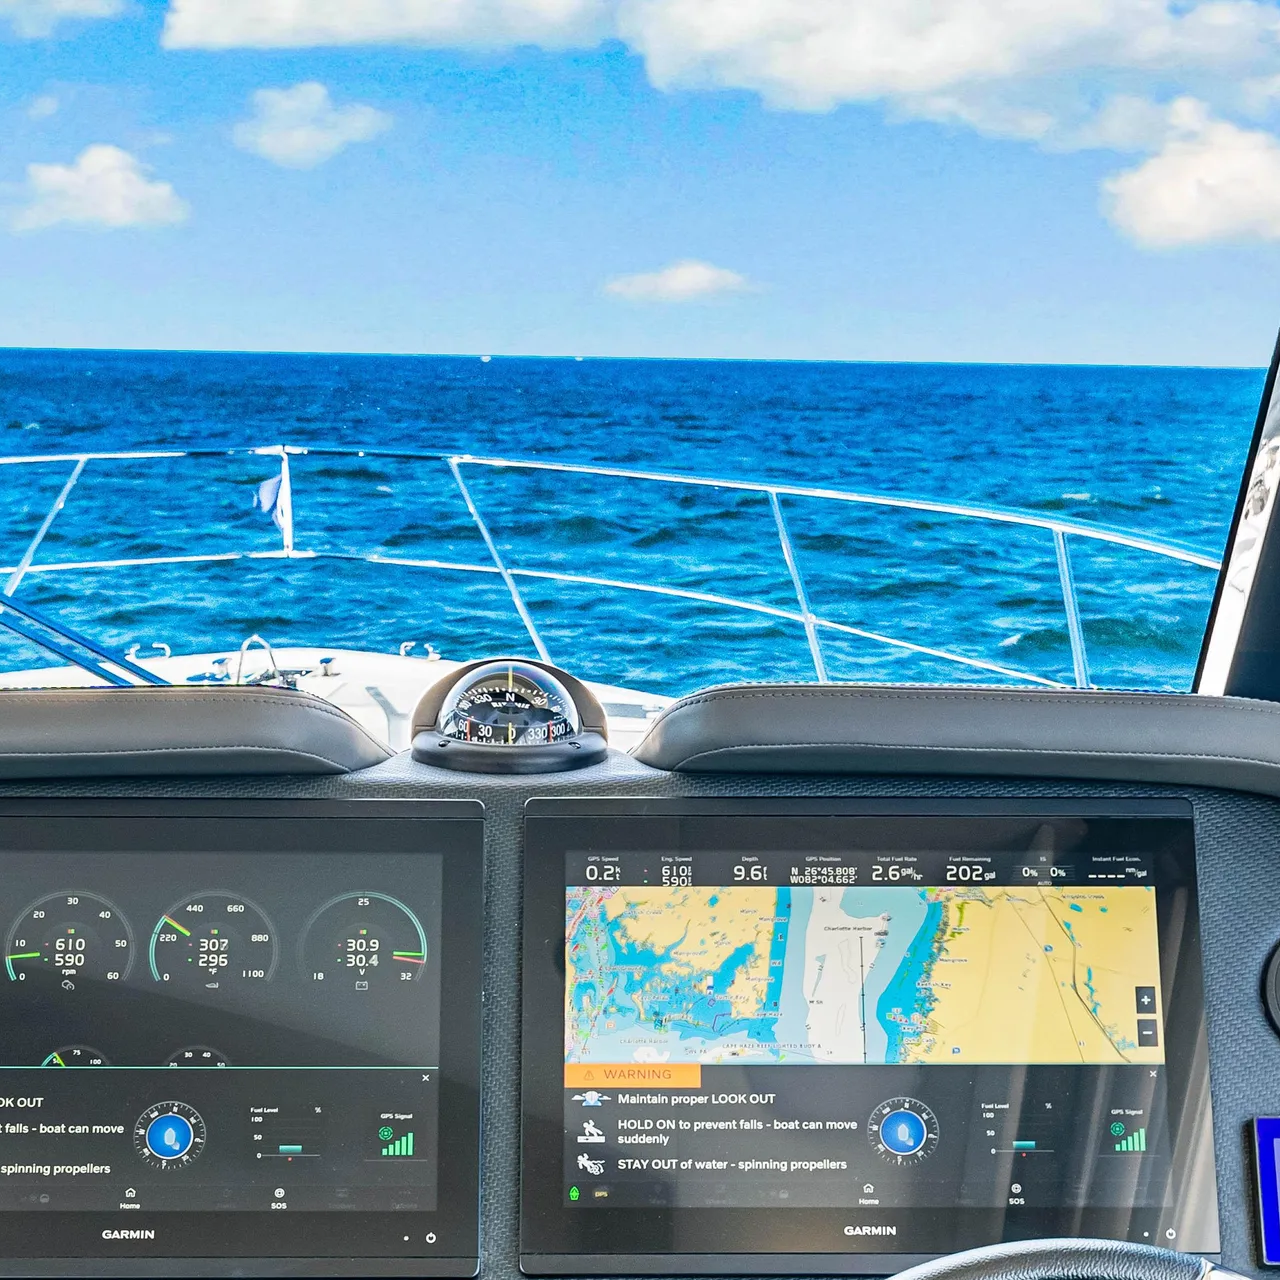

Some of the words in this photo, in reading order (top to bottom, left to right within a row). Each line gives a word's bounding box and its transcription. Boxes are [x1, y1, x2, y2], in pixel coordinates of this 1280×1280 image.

[471, 694, 492, 704] 330
[506, 693, 515, 702] N
[531, 697, 546, 705] 30
[478, 725, 492, 737] 30
[527, 728, 547, 740] 330
[552, 724, 565, 737] 300
[946, 866, 983, 880] 202
[984, 871, 995, 880] gal
[1022, 867, 1038, 877] 0%
[1050, 867, 1066, 877] 0%
[67, 897, 79, 905] 30
[99, 911, 111, 919] 40
[159, 934, 177, 942] 220
[251, 934, 269, 942] 880
[55, 938, 85, 950] 610
[199, 939, 228, 950] 307
[346, 939, 379, 951] 30.9
[55, 954, 84, 966] 590
[198, 955, 228, 966] 296
[346, 955, 379, 966] 30.4
[107, 972, 119, 980] 60
[242, 970, 264, 978] 1100
[604, 1069, 672, 1079] WARNING
[17, 1098, 43, 1108] OUT
[618, 1094, 668, 1104] Maintain
[671, 1095, 709, 1106] proper
[712, 1094, 747, 1104] LOOK
[750, 1094, 776, 1104] OUT
[5, 1123, 29, 1133] falls
[40, 1123, 65, 1134] boat
[68, 1126, 89, 1134] can
[92, 1126, 124, 1134] move
[618, 1120, 653, 1129] HOLD
[657, 1120, 676, 1129] ON
[679, 1121, 690, 1130] to
[694, 1121, 737, 1132] prevent
[740, 1120, 763, 1130] falls
[774, 1120, 799, 1130] boat
[803, 1122, 823, 1130] can
[826, 1122, 857, 1130] move
[618, 1134, 669, 1146] suddenly
[1, 1163, 50, 1176] spinning
[54, 1163, 111, 1176] propellers
[618, 1160, 649, 1169] STAY
[652, 1160, 678, 1169] OUT
[681, 1159, 693, 1169] of
[695, 1160, 728, 1169] water
[738, 1159, 787, 1172] spinning
[790, 1159, 847, 1172] propellers
[101, 1230, 155, 1239] GARMIN
[844, 1226, 897, 1236] GARMIN
